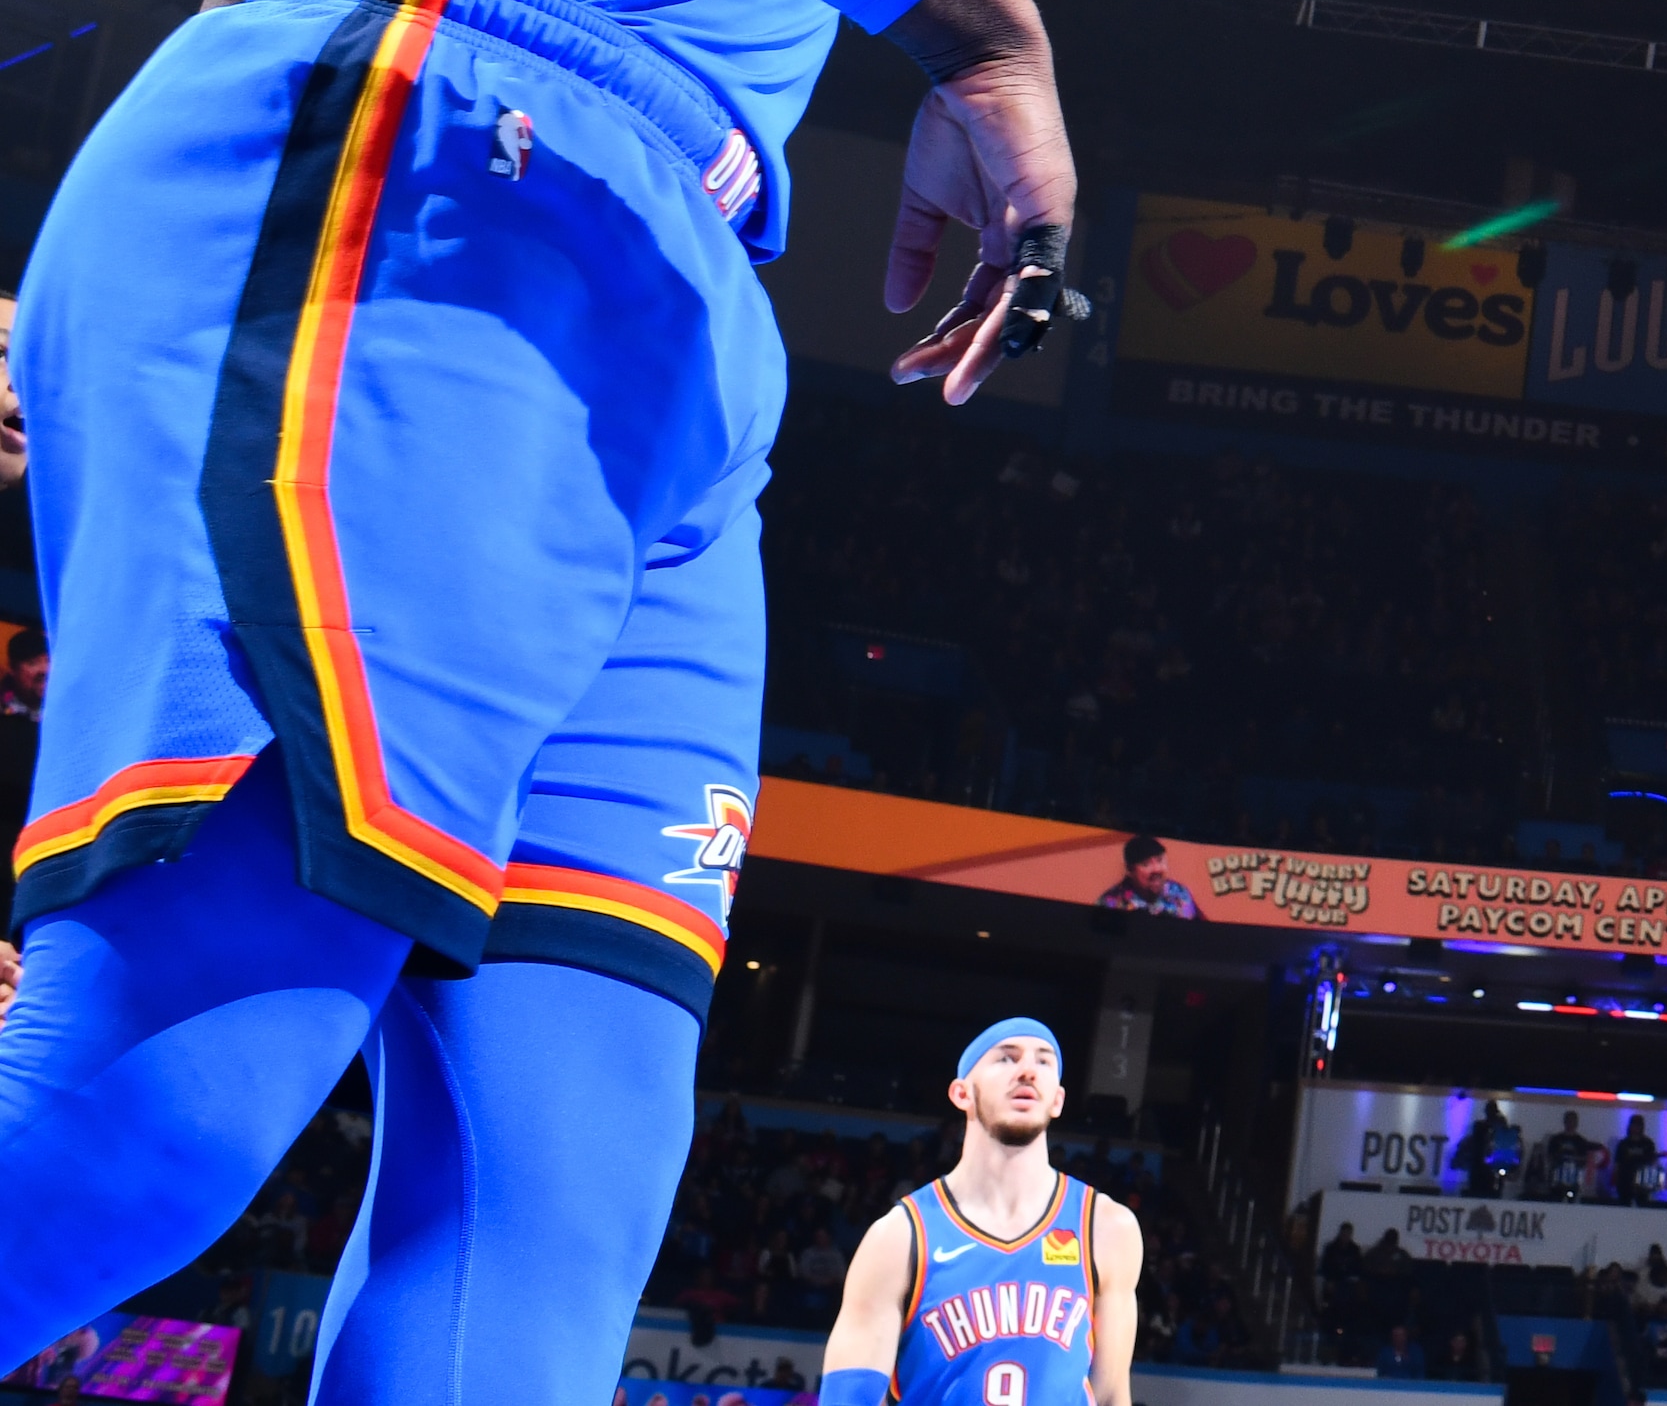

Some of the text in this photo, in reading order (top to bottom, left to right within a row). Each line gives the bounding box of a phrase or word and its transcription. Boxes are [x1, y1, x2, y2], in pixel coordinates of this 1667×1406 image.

[1168, 378, 1301, 416] BRING
[1314, 393, 1394, 426] THE
[1408, 404, 1601, 450] THUNDER
[1207, 852, 1372, 883] DON'T WORRY
[1210, 868, 1370, 913] BE Fluffy
[1407, 869, 1605, 913] SATURDAY,
[1289, 902, 1349, 926] TOUR
[1438, 903, 1584, 940] PAYCOM
[1361, 1130, 1449, 1177] POST
[1406, 1204, 1546, 1240] POST OAK
[1424, 1238, 1523, 1264] TOYOTA
[924, 1281, 1088, 1361] THUNDER
[985, 1361, 1027, 1406] 9
